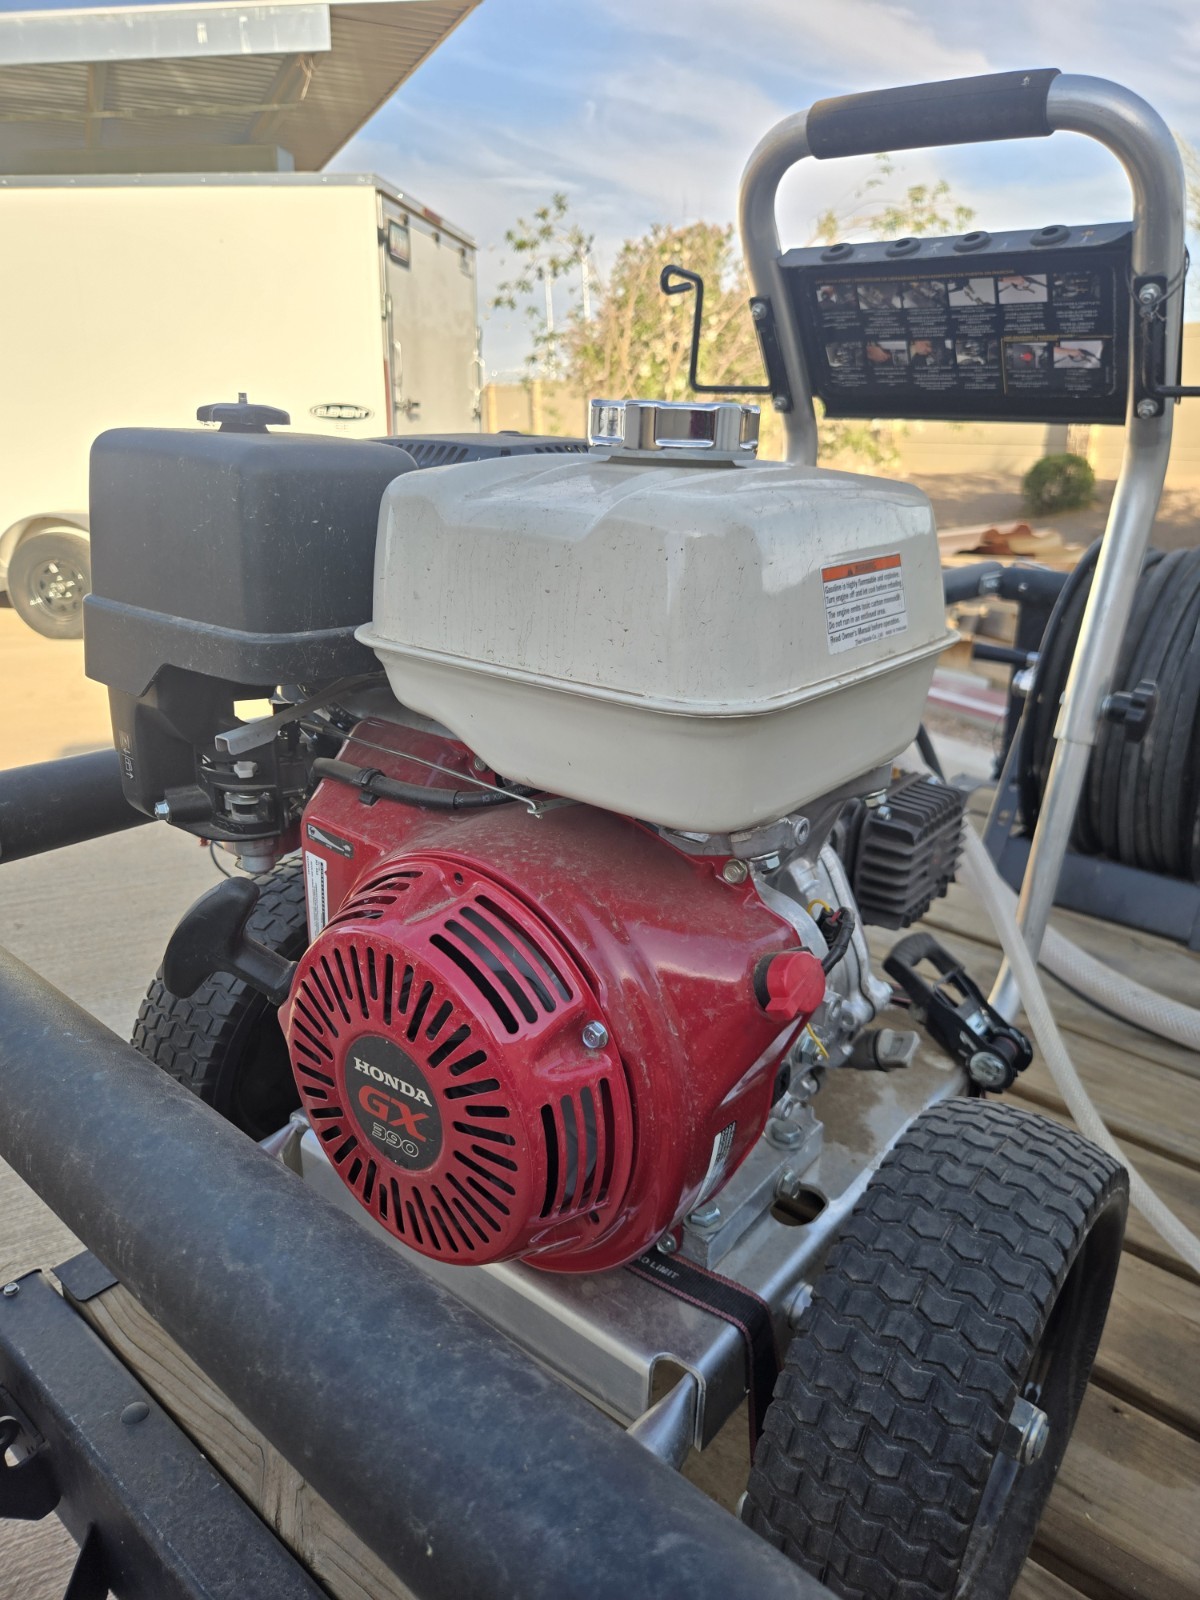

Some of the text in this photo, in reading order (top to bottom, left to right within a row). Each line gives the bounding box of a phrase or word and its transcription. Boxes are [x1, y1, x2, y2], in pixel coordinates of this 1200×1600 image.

[825, 583, 842, 594] Gasoline
[847, 580, 858, 591] highly
[858, 575, 877, 586] flammable
[826, 595, 835, 604] Turn
[836, 593, 849, 603] engine
[868, 586, 876, 594] cool
[876, 583, 887, 591] before
[836, 607, 850, 618] engine
[850, 604, 861, 613] emits
[871, 598, 883, 607] carbon
[860, 609, 876, 620] enclosed
[830, 634, 841, 644] Read
[842, 629, 857, 640] Owner's
[858, 625, 871, 635] Manual
[871, 621, 883, 631] before
[353, 1056, 433, 1107] HONDA
[358, 1085, 429, 1142] GX
[371, 1122, 419, 1157] 390
[650, 1261, 680, 1279] LIMIT
